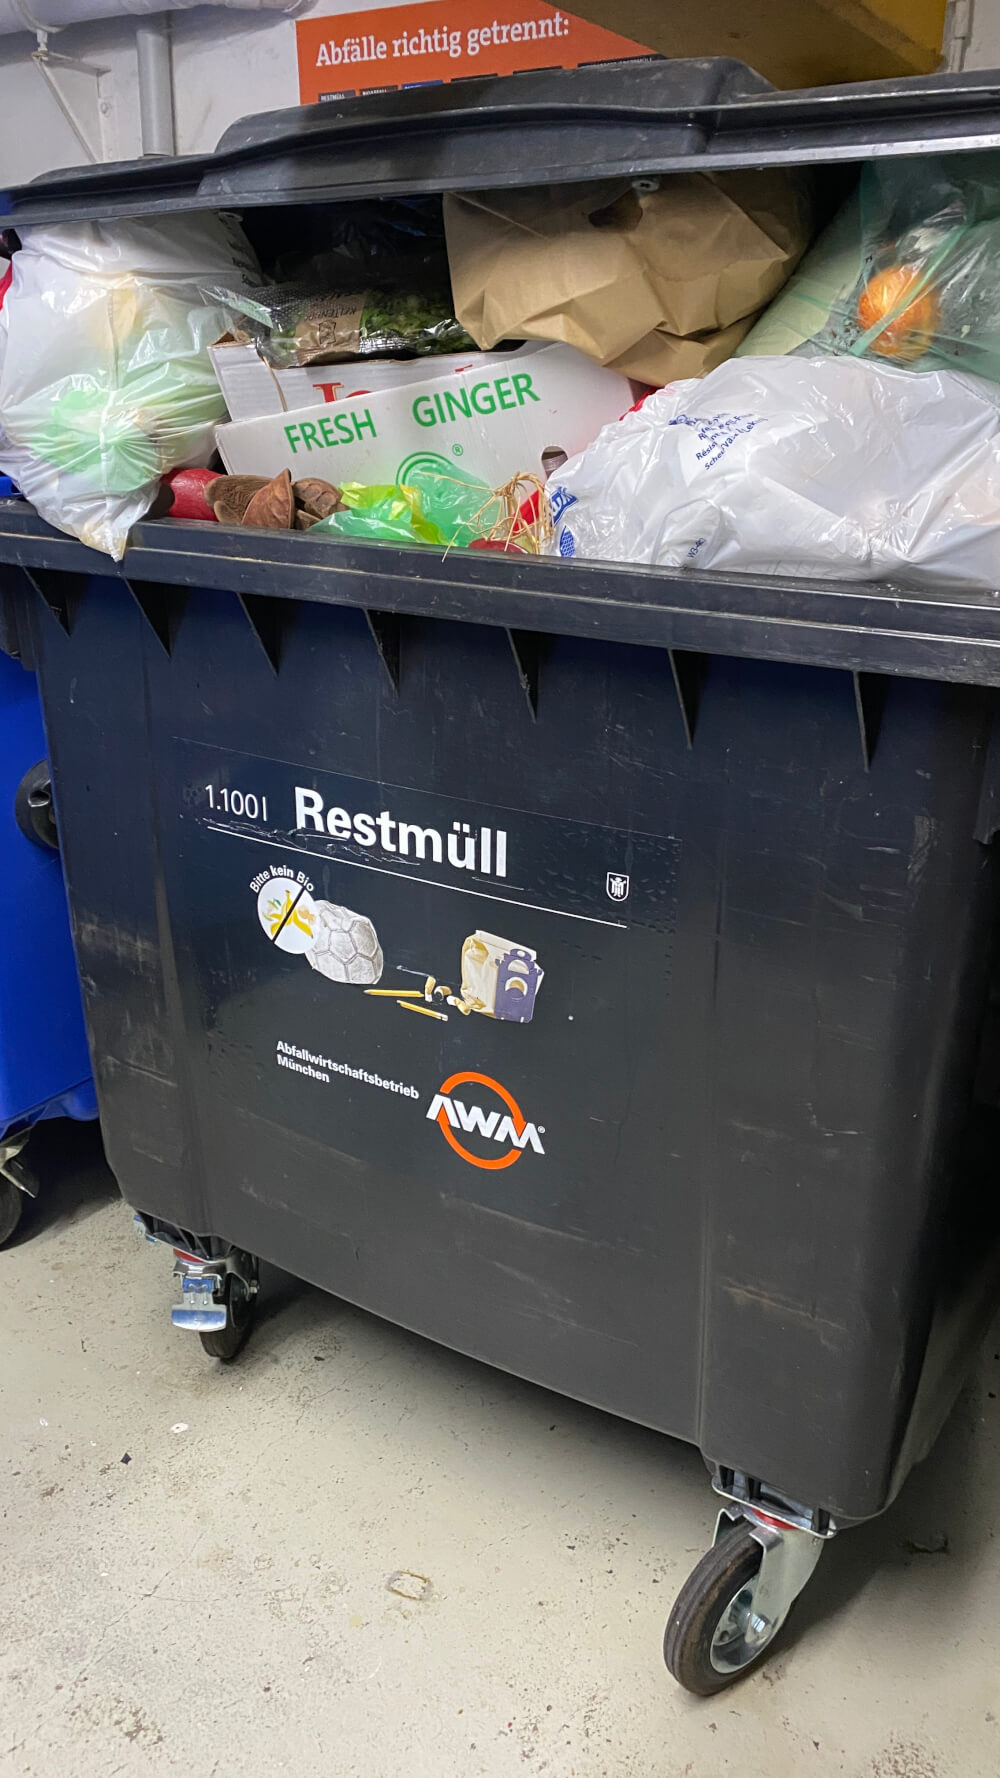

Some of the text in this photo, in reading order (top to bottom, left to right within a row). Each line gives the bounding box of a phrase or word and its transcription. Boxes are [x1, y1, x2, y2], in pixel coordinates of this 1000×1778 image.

[315, 11, 569, 67] Abfälle richtig getrennt:
[284, 409, 377, 453] FRESH
[413, 373, 540, 427] GINGER
[294, 786, 507, 878] Restmüll
[249, 864, 314, 893] Bitte kein Bio
[276, 1054, 331, 1084] München
[276, 1040, 420, 1100] Abfallwirtschaftsbetrieb
